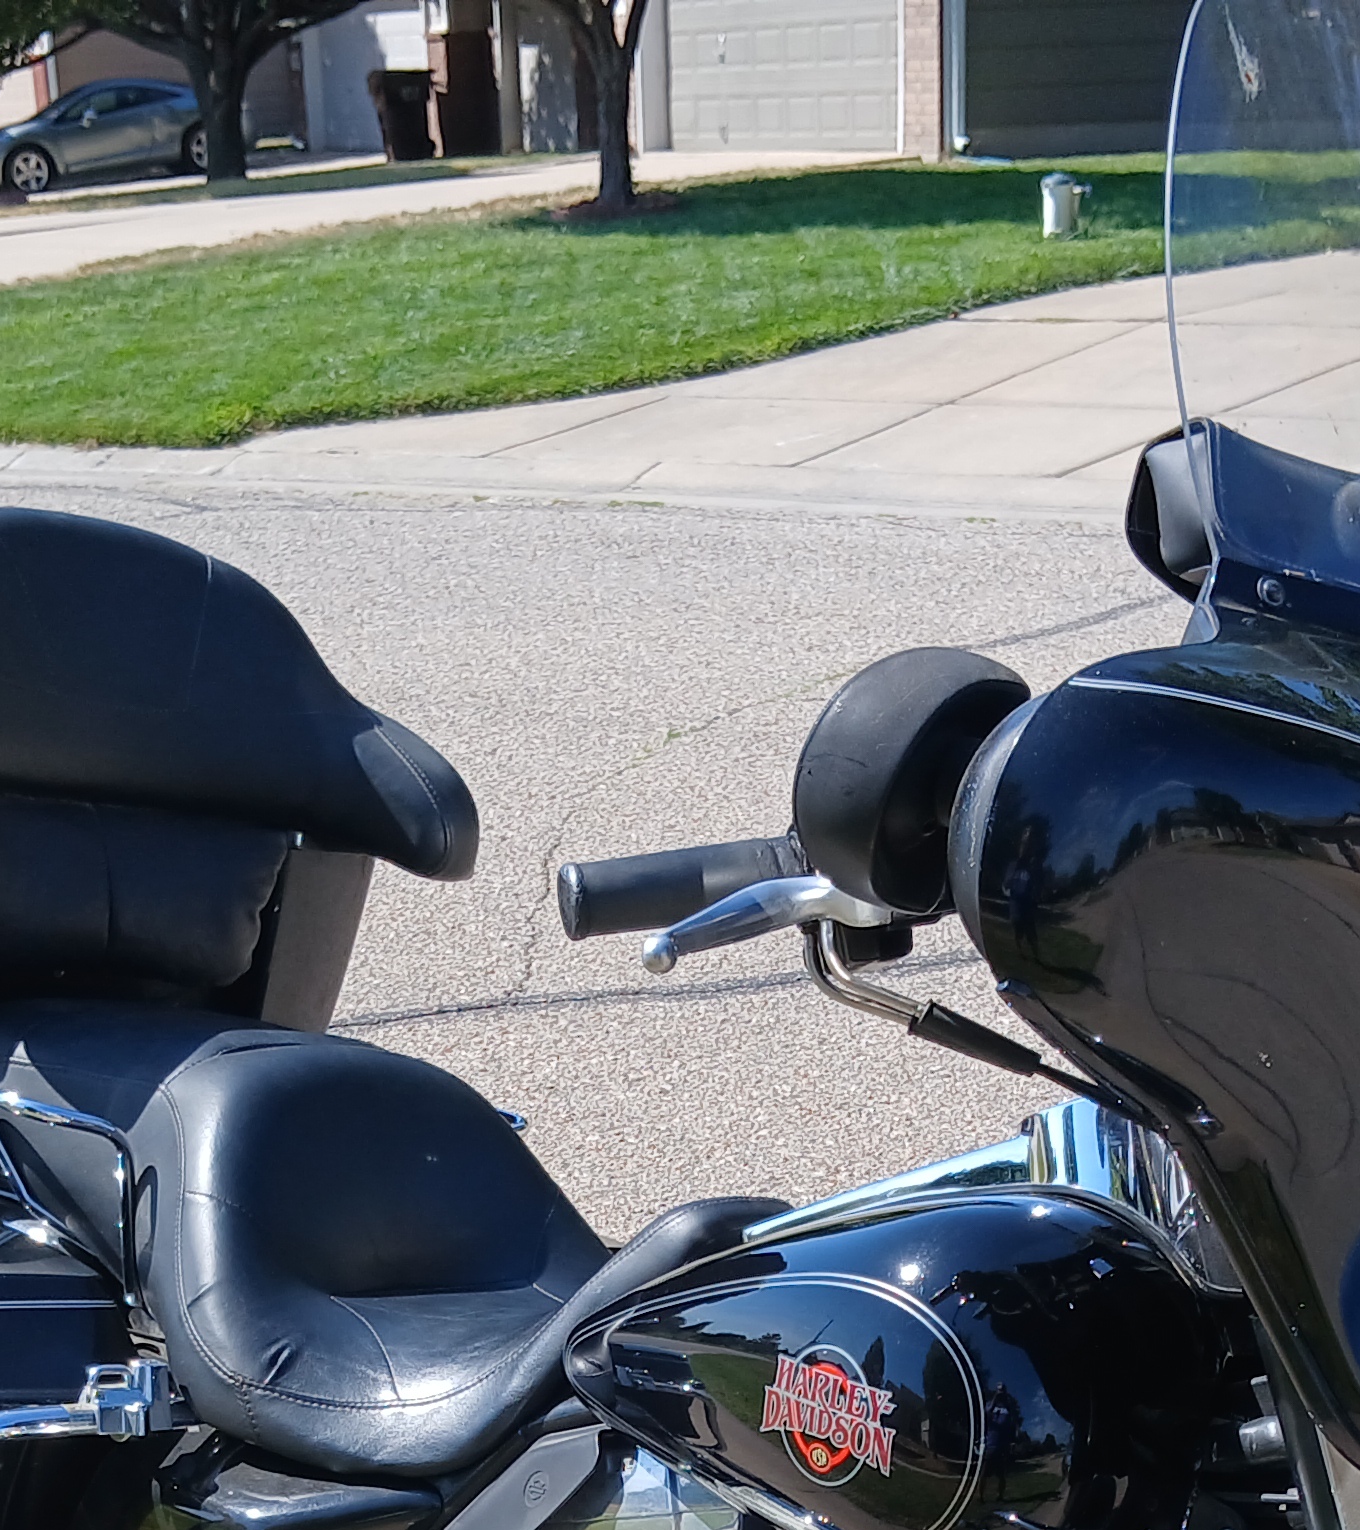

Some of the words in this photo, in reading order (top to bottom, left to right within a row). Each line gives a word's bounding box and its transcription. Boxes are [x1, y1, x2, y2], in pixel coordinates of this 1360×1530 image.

[774, 1354, 897, 1423] HARLEY-
[760, 1386, 897, 1478] DAVIDSON
[811, 1449, 828, 1467] USA
